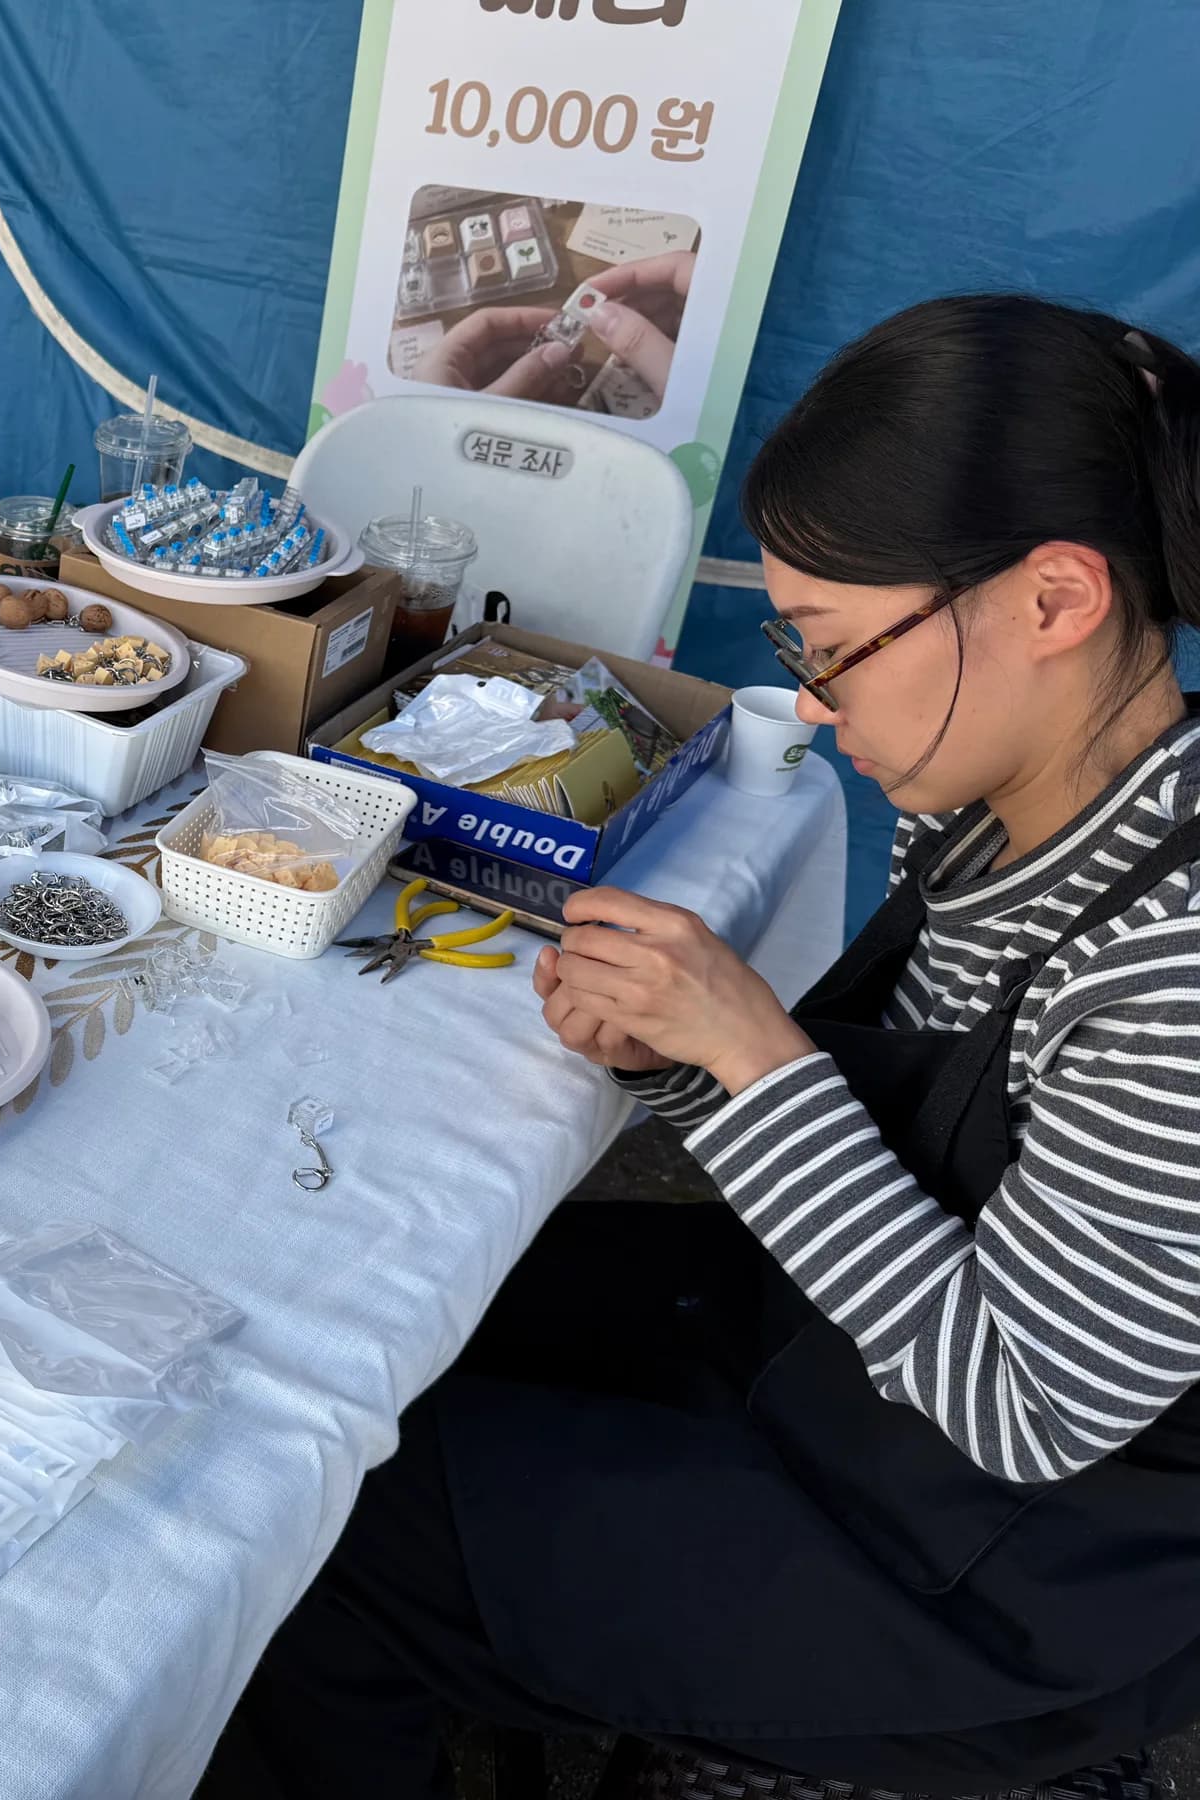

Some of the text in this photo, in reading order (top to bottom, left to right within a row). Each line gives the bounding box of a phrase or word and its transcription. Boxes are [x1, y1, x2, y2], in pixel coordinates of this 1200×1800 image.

[424, 77, 715, 162] 10,000 원
[471, 437, 563, 477] 설문 조사
[422, 801, 586, 870] Double A
